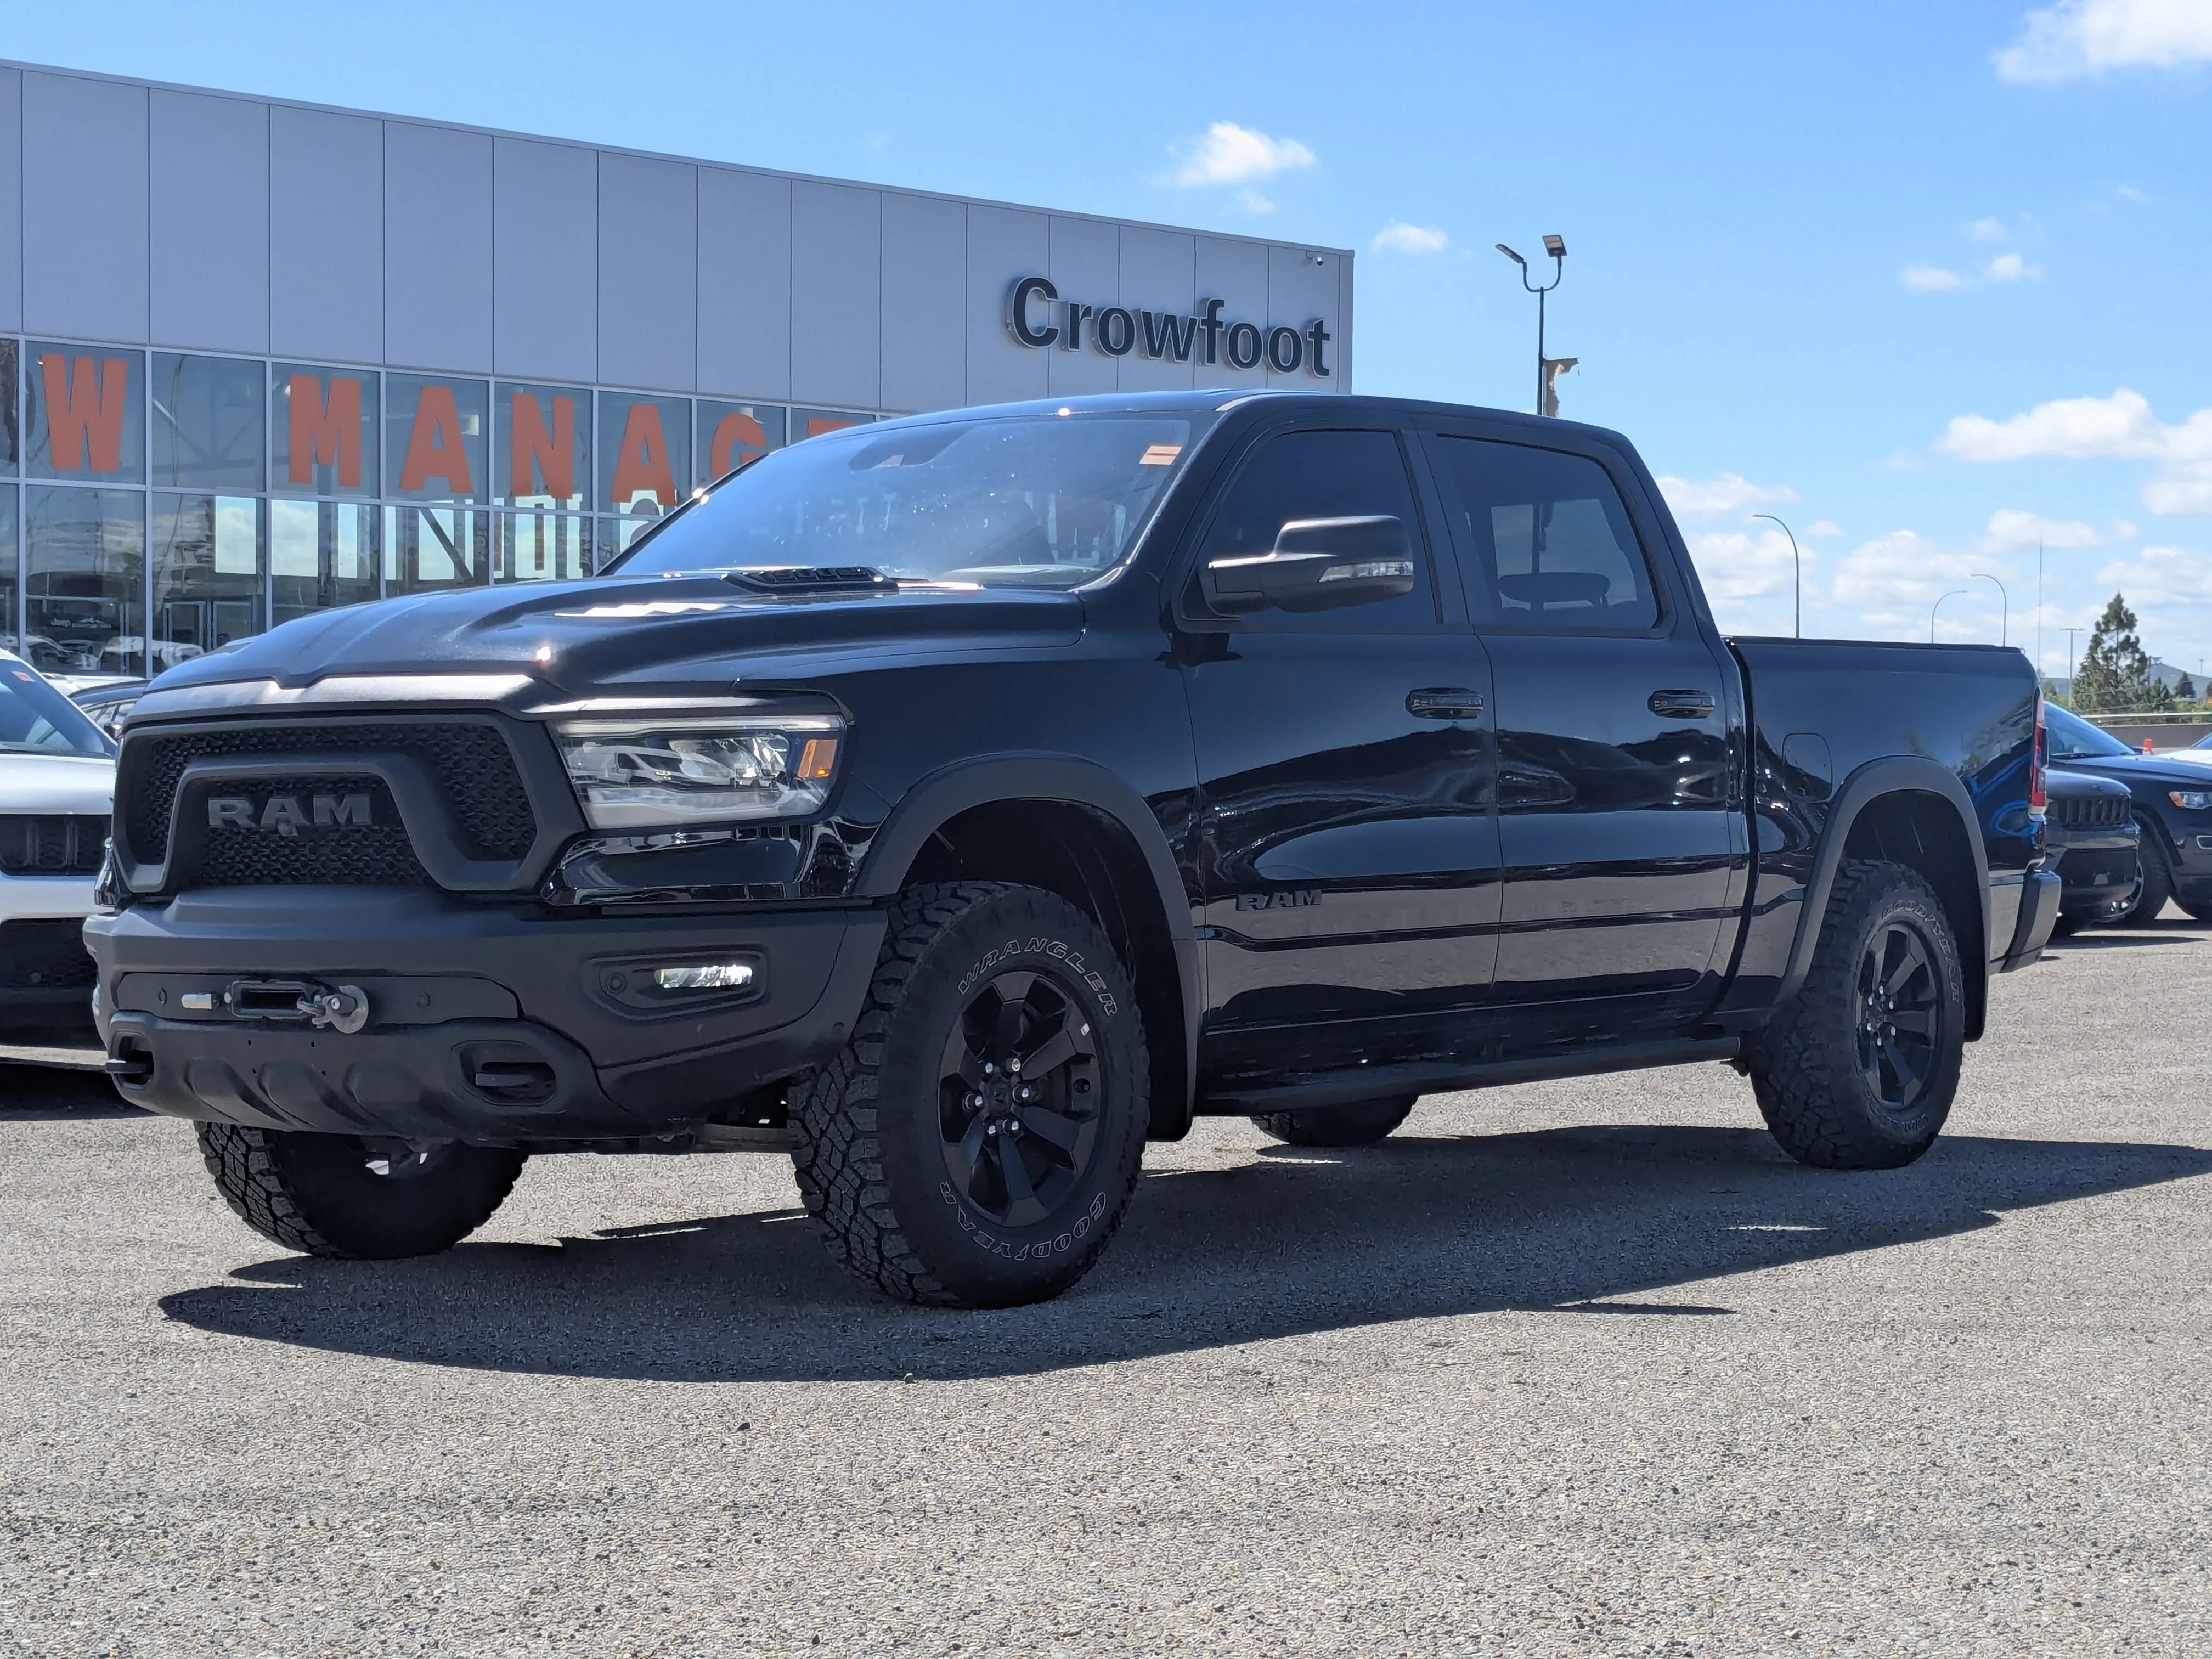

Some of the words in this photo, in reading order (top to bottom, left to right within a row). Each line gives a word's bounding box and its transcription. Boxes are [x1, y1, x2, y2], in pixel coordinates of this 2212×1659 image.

[1008, 276, 1330, 378] Crowfoot
[289, 375, 855, 507] MANAG
[208, 793, 372, 827] RAM
[1237, 889, 1323, 911] RAM
[957, 936, 1118, 1017] WRANGLER
[939, 1180, 1107, 1262] GOODYEAR
